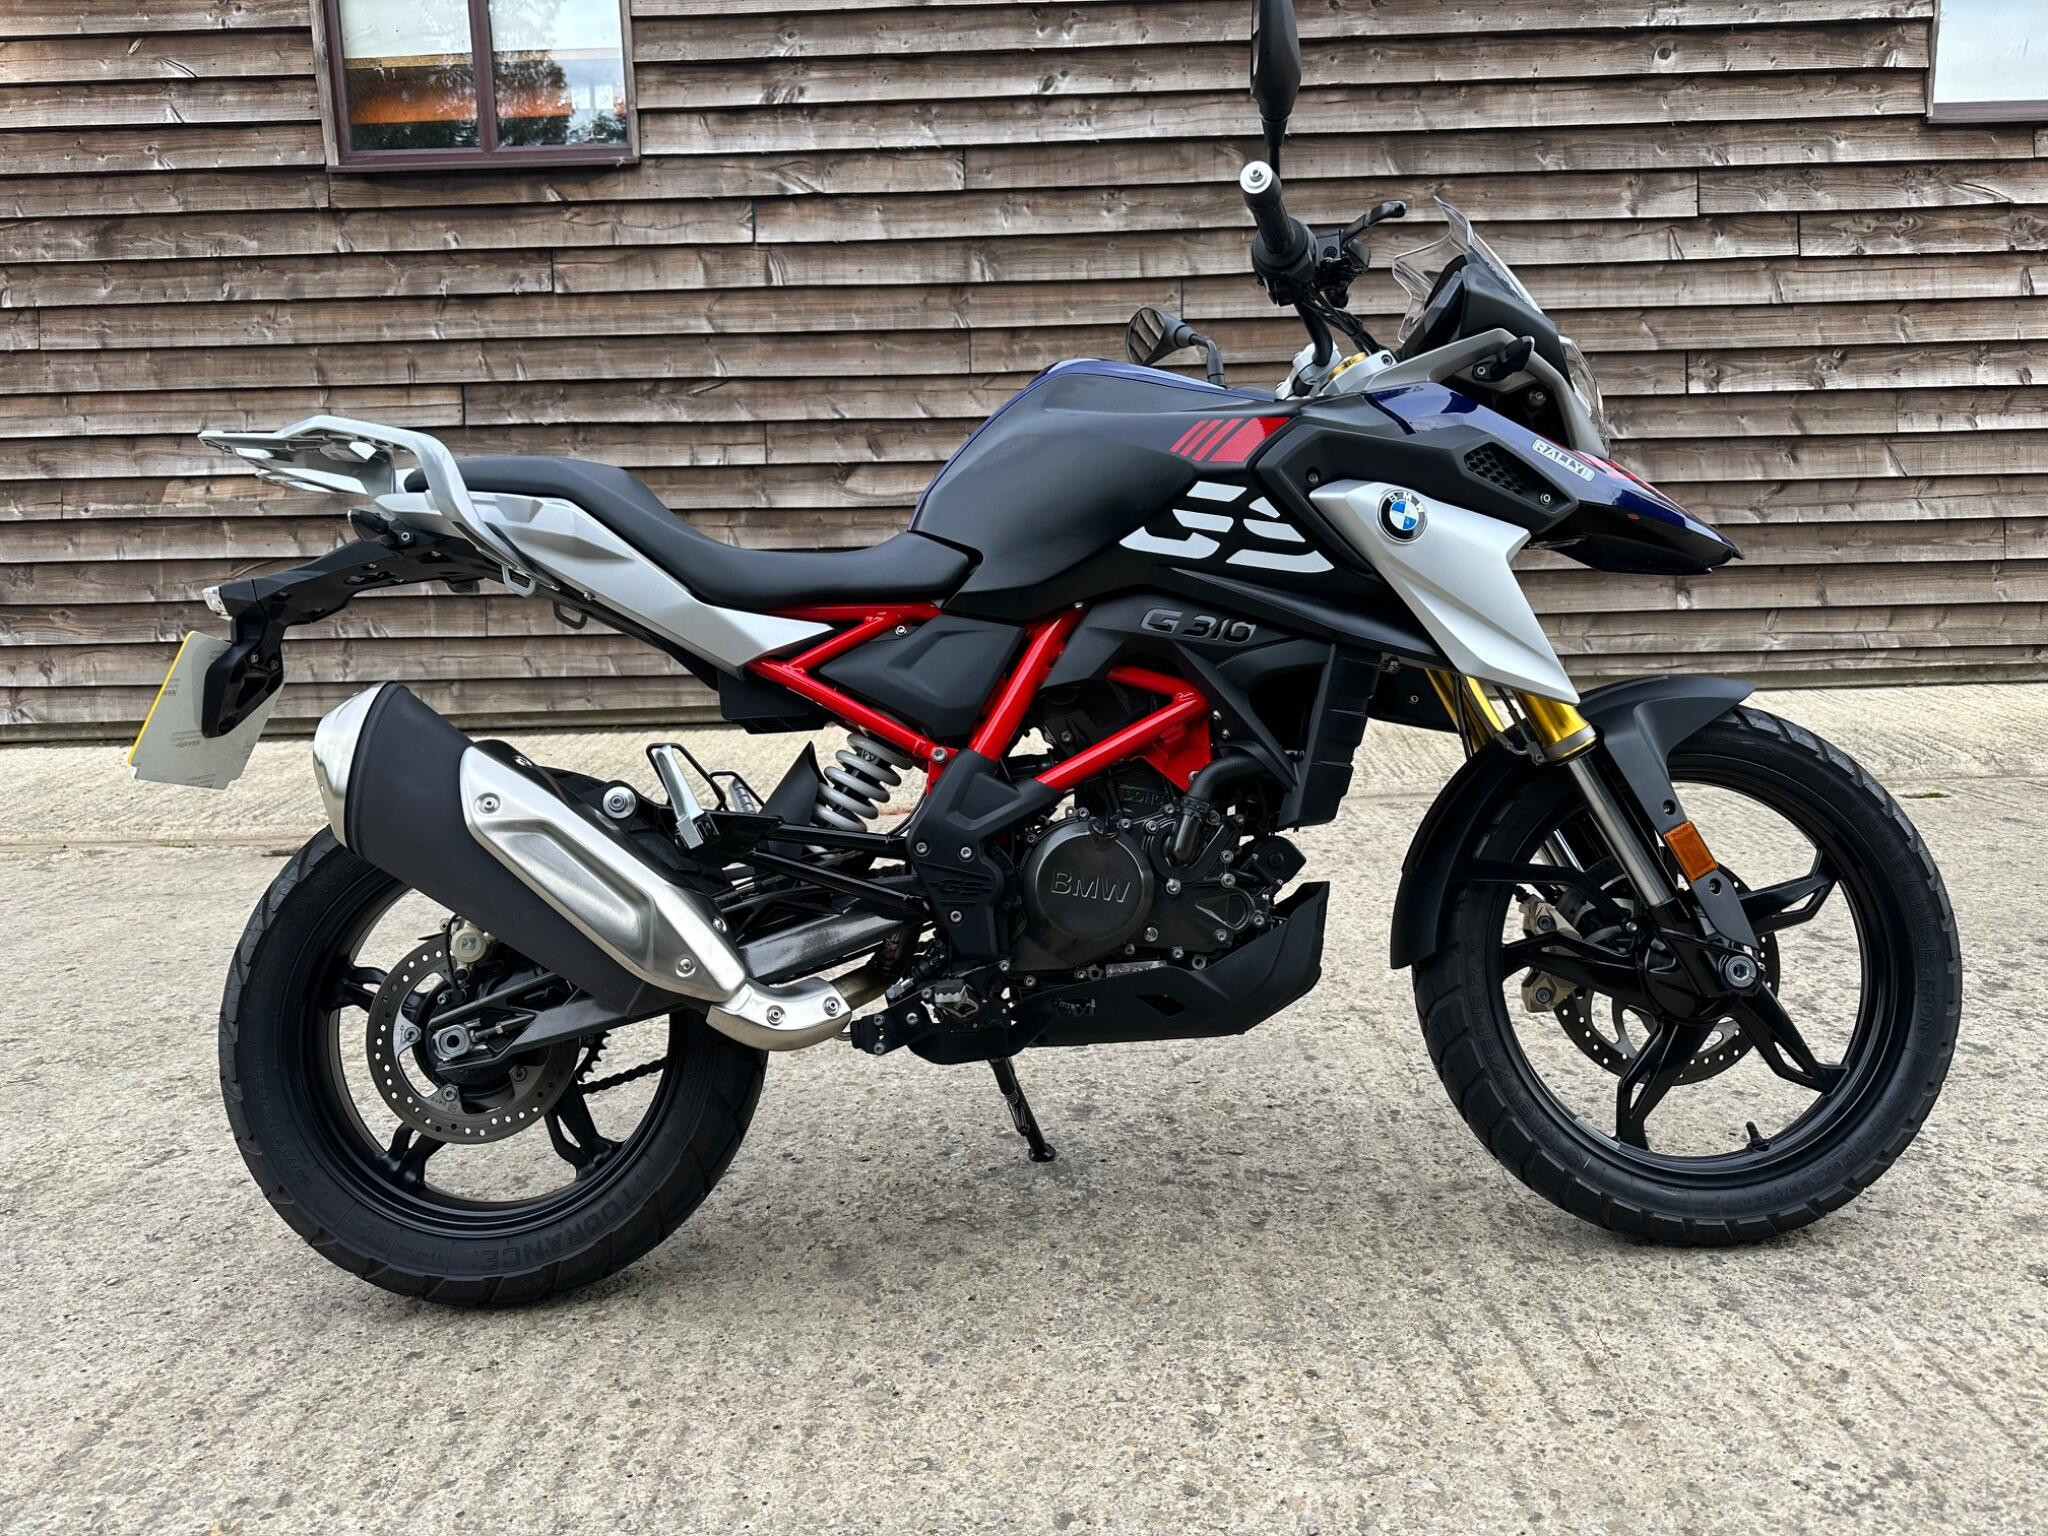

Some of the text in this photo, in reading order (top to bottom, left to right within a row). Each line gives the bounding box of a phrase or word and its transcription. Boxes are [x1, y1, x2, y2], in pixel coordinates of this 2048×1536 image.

[1388, 491, 1425, 513] BMW
[1141, 608, 1257, 644] G 310
[1050, 870, 1132, 904] BMW
[480, 1188, 643, 1273] TOURANCE
